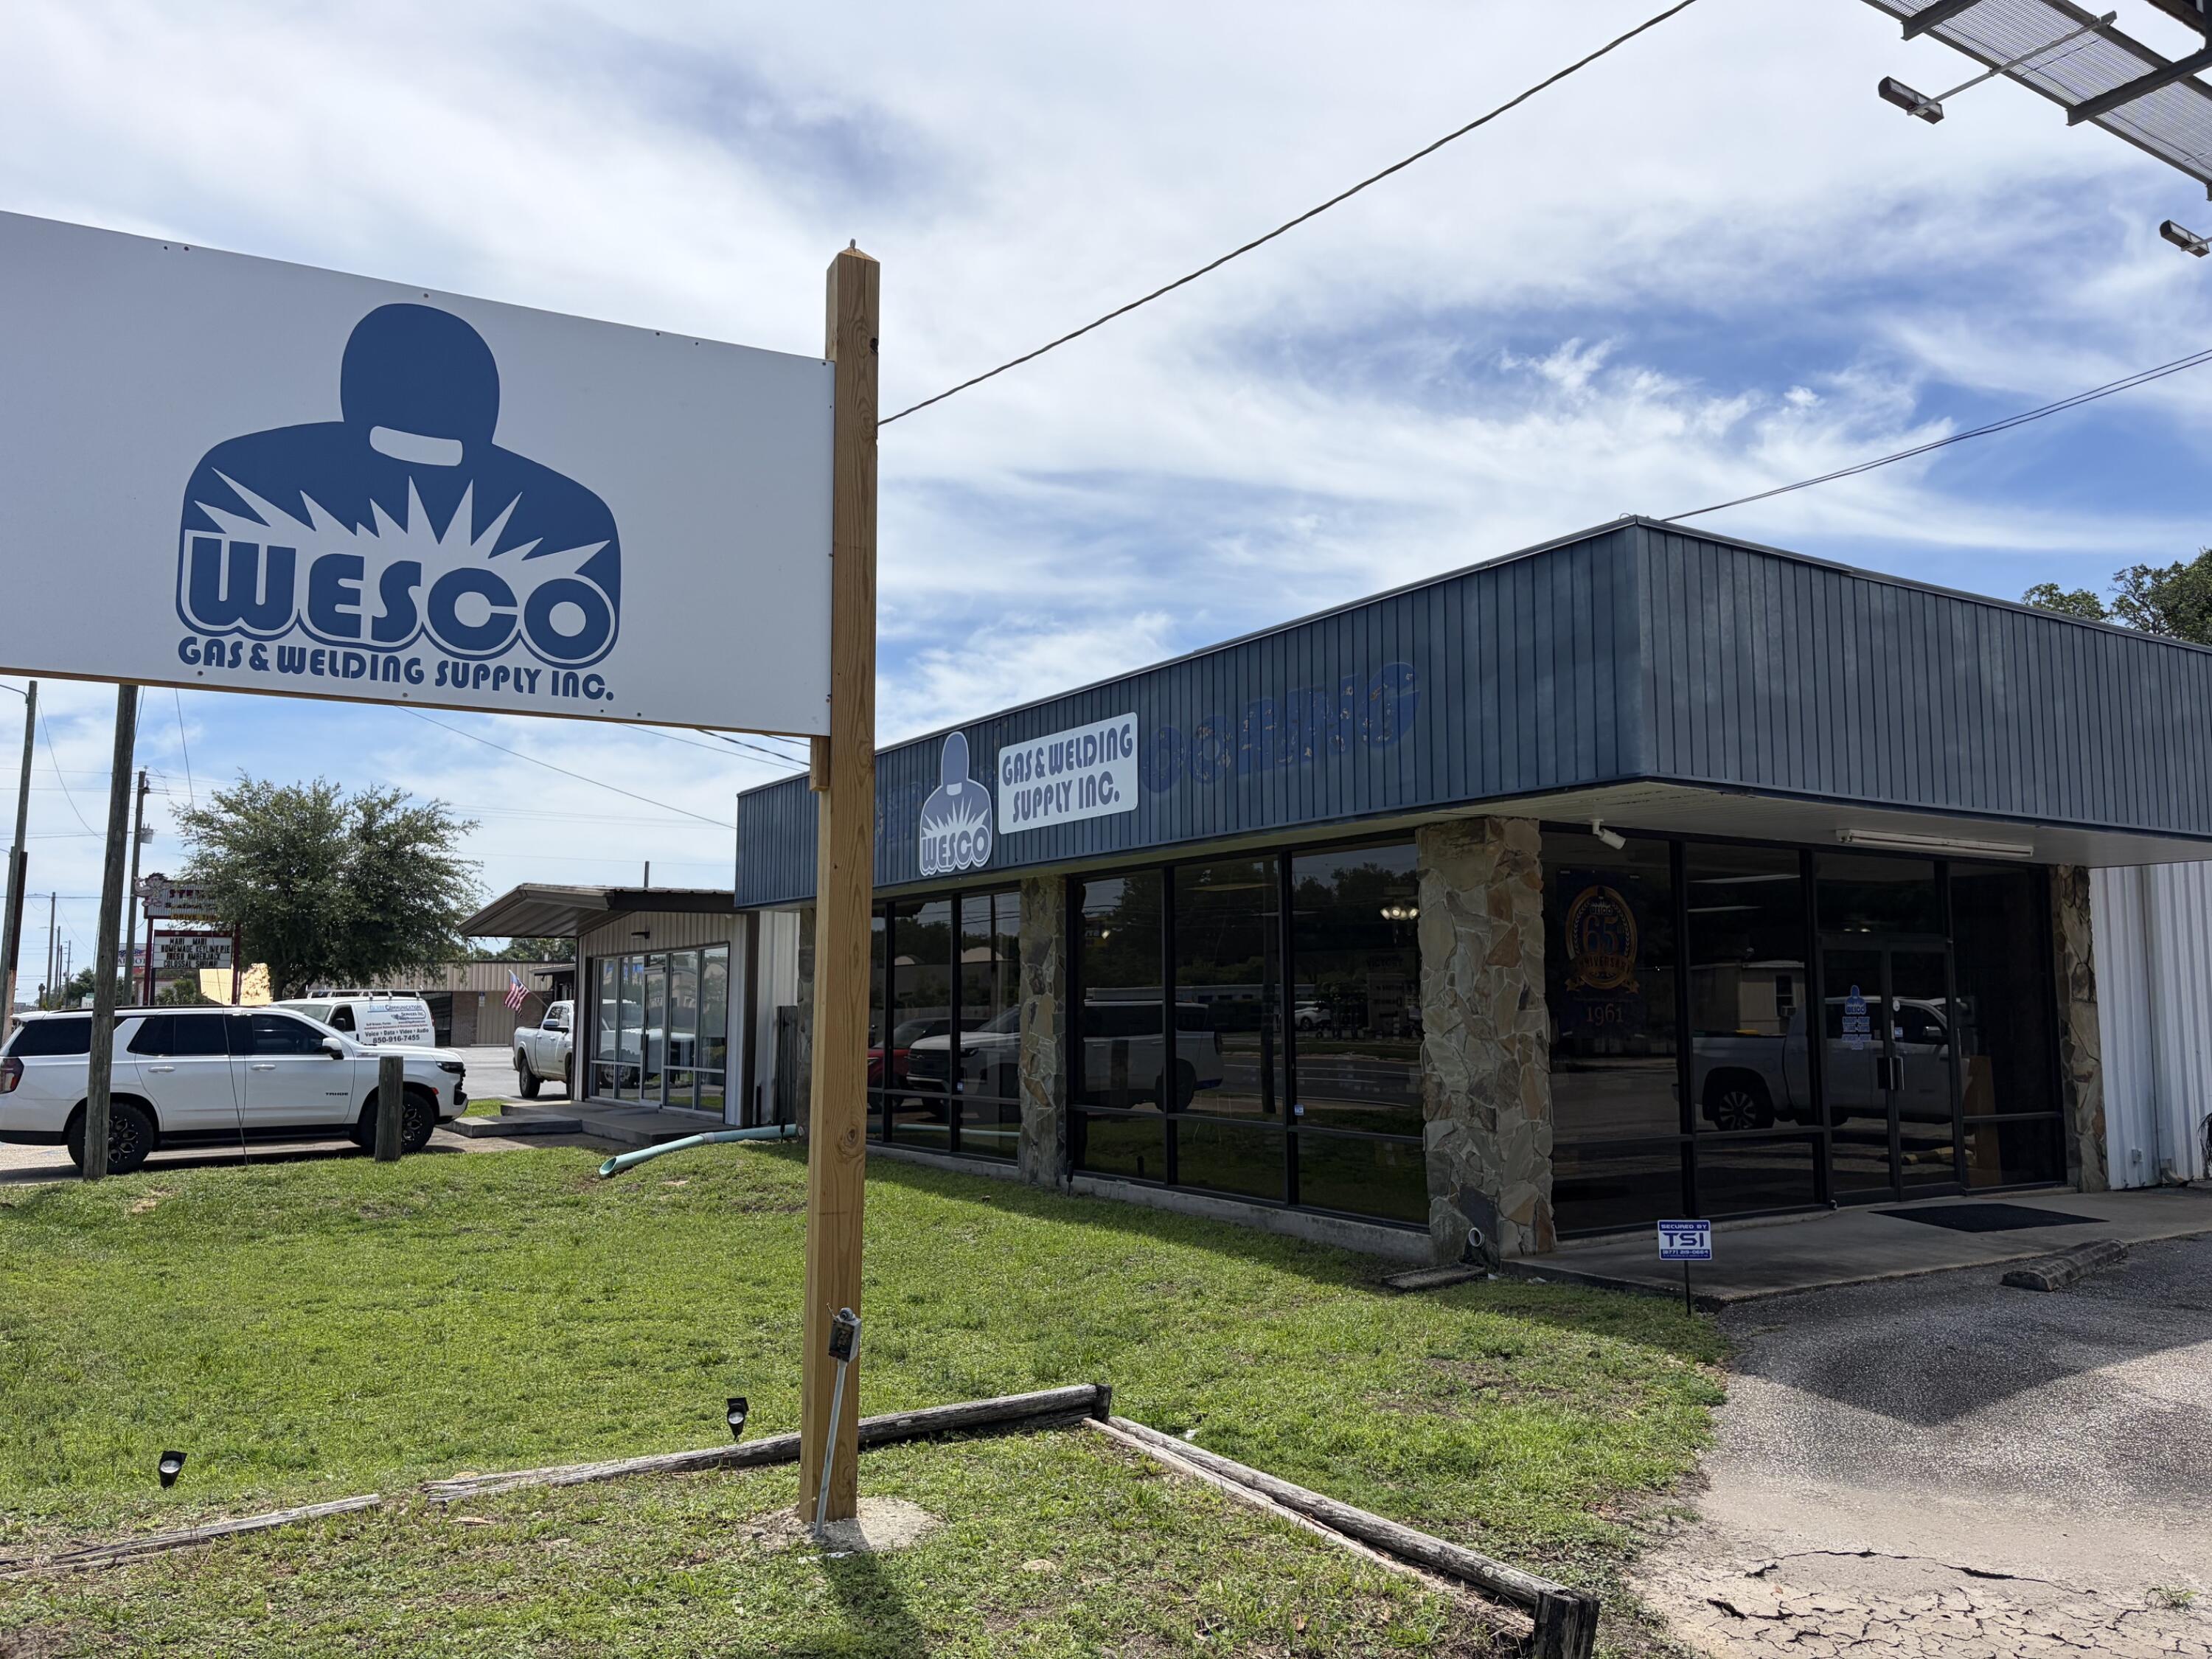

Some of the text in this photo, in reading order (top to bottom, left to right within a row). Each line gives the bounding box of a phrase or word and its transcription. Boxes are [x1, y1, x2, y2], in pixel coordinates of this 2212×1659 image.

[189, 536, 611, 660] WESCO
[178, 636, 614, 701] GAS & WELDING SUPPLY INC.
[1002, 723, 1133, 786] GAS & WELDING
[1013, 771, 1120, 823] SUPPLY INC.
[922, 827, 989, 871] WESCO
[161, 945, 193, 953] HOMEMADE
[1586, 1003, 1624, 1026] 1961
[372, 1034, 420, 1043] 850-916-7455
[1662, 1232, 1705, 1248] TSI
